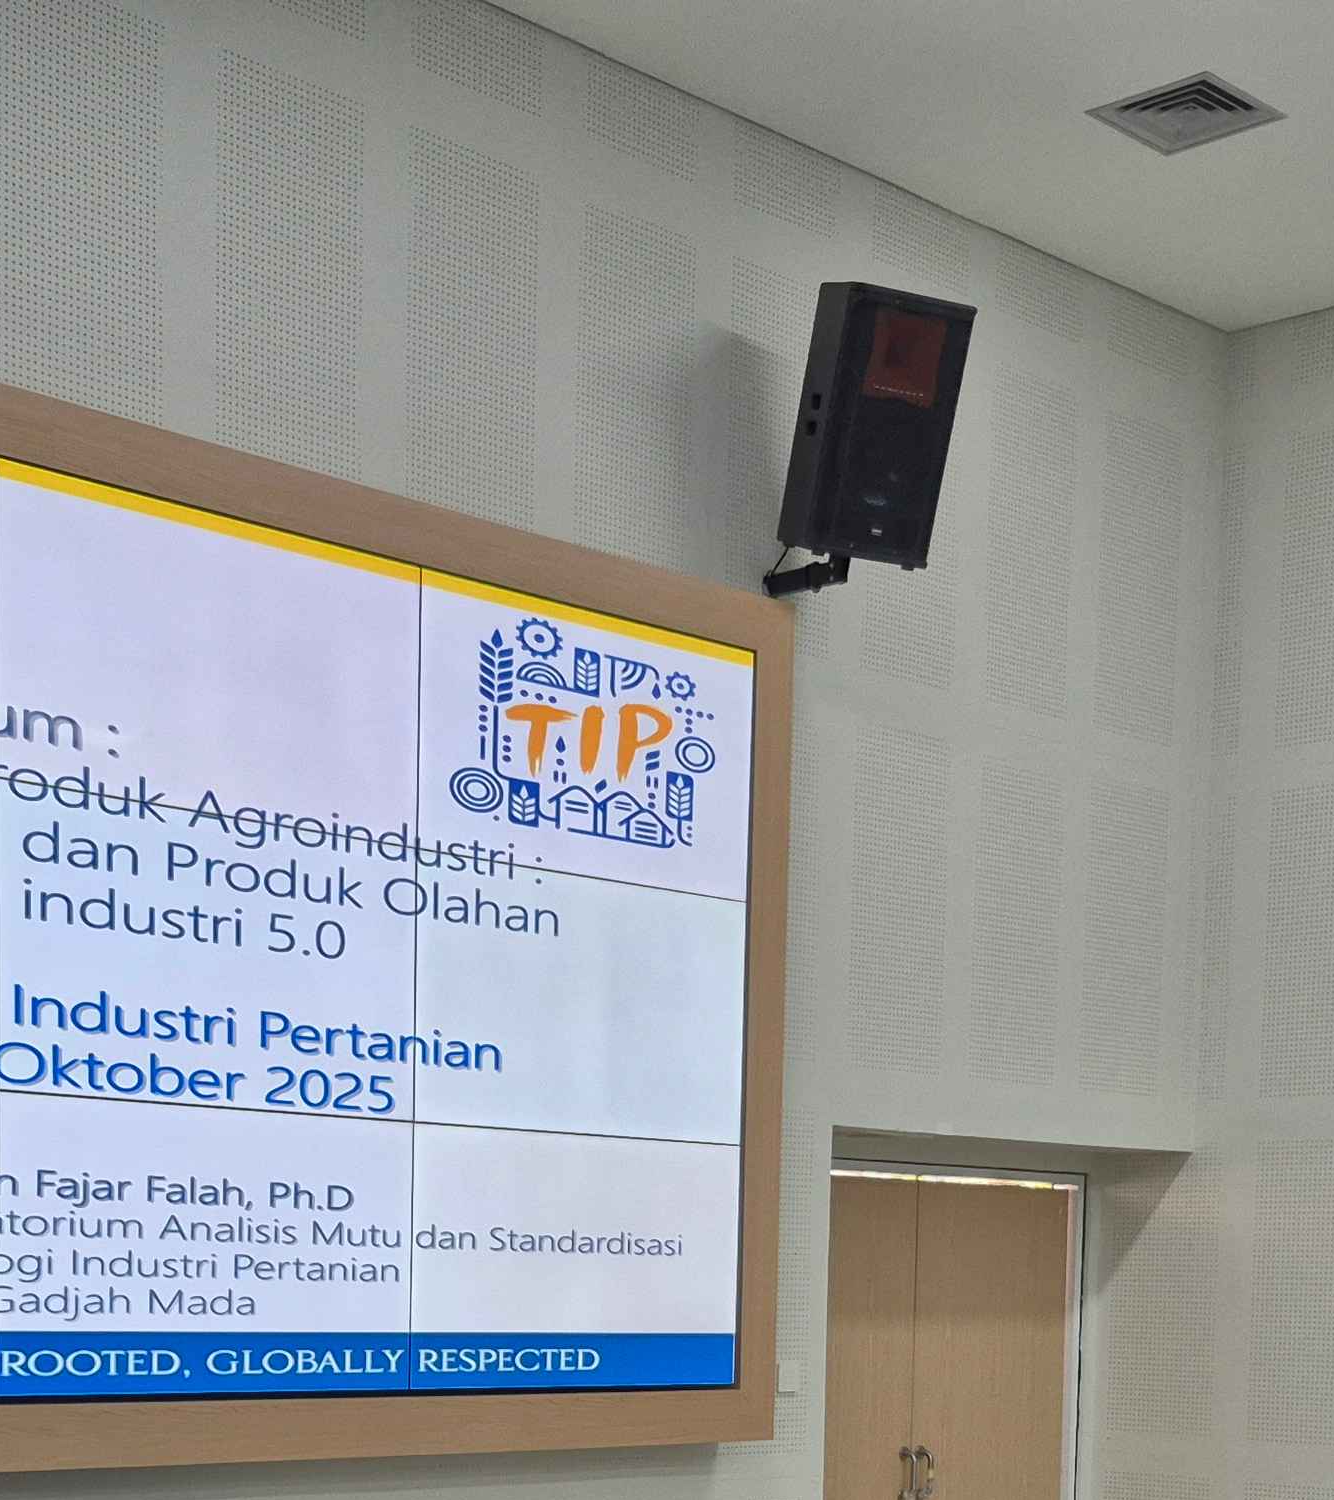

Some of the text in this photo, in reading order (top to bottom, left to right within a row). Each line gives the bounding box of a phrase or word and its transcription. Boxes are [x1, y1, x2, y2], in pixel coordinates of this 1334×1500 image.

[504, 703, 674, 784] TIP
[188, 790, 515, 880] Agroindustri
[22, 821, 139, 876] dan
[167, 841, 363, 909] Produk
[383, 877, 559, 937] Olahan
[23, 877, 243, 948] industri
[267, 915, 346, 960] 5.0
[12, 981, 238, 1050] Industri
[258, 1008, 502, 1074] Pertanian
[265, 1065, 396, 1115] 2025
[36, 1169, 132, 1208] Fajar
[147, 1175, 253, 1211] Falah,
[269, 1181, 354, 1212] Ph.D
[159, 1215, 297, 1247] Analisis
[312, 1220, 401, 1249] Mutu
[416, 1224, 476, 1251] dan
[489, 1226, 683, 1257] Standardisasi
[71, 1249, 218, 1280] Industri
[233, 1254, 400, 1284] Pertanian
[148, 1287, 256, 1316] Mada
[0, 1349, 191, 1378] ROOTED,
[206, 1349, 406, 1375] GLOBALLY
[418, 1347, 601, 1373] RESPECTED
